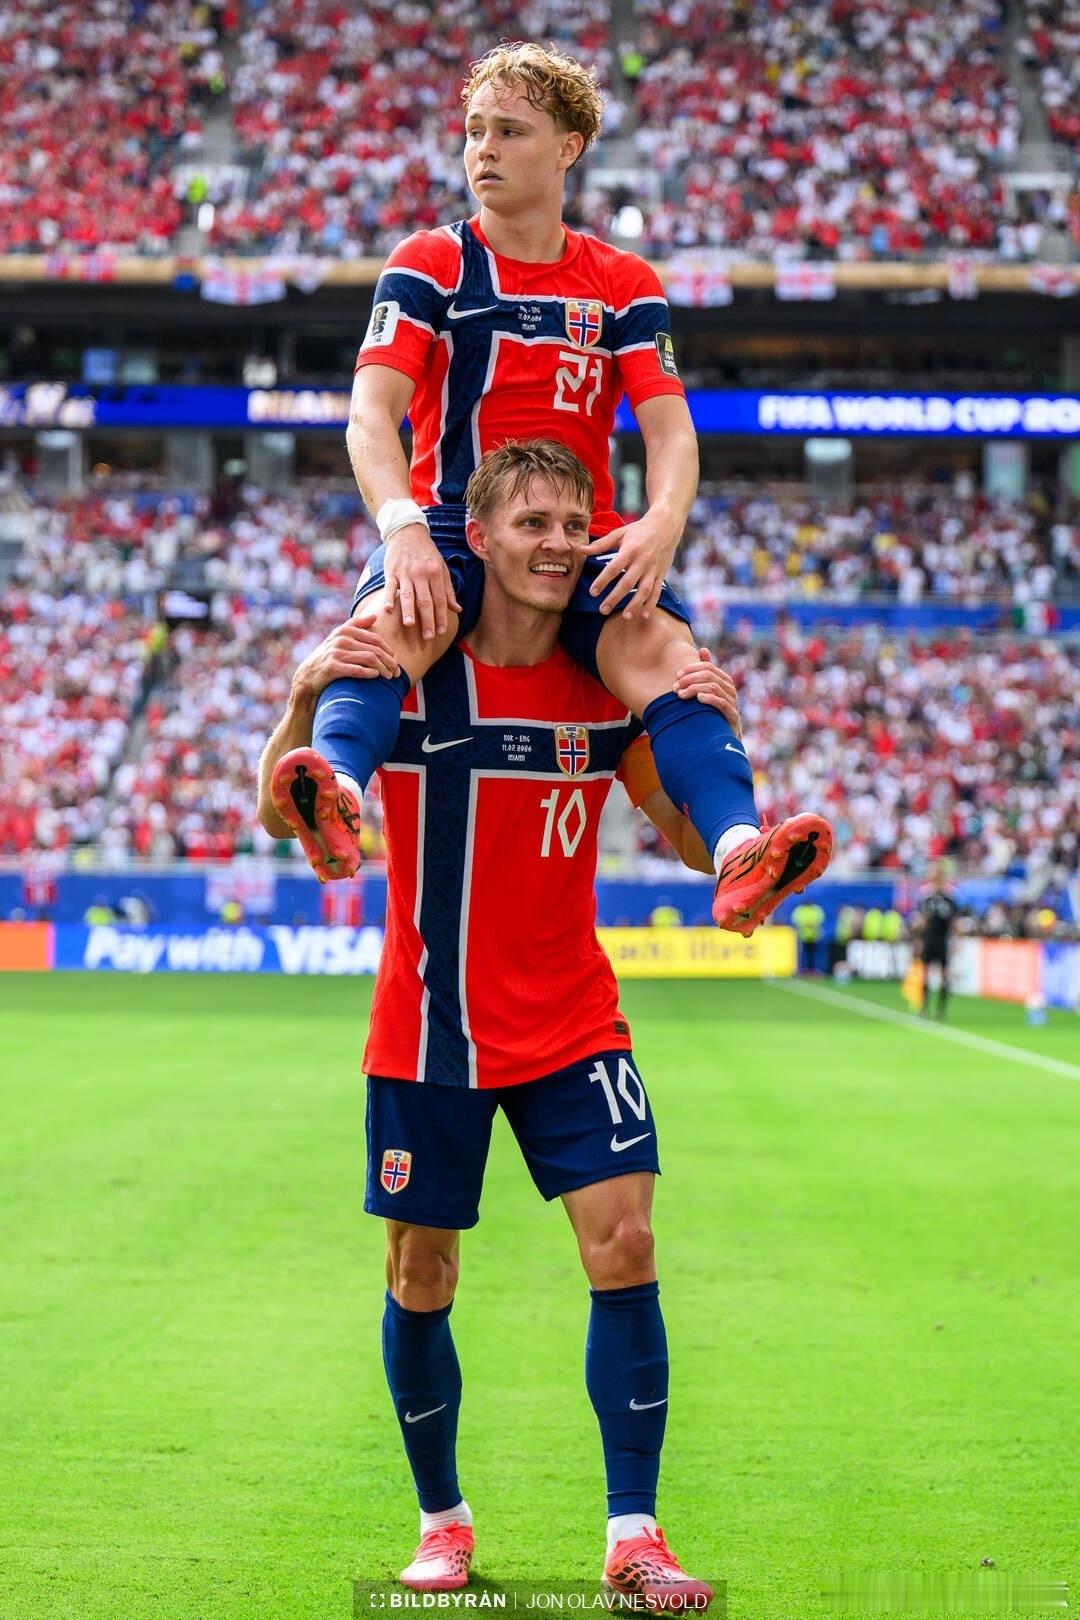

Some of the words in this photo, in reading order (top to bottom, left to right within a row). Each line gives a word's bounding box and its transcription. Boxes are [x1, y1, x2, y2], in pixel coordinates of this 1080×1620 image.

[553, 350, 603, 416] 21
[758, 395, 833, 430] FIFA
[834, 396, 952, 431] WORLD
[954, 397, 1022, 431] CUP
[540, 789, 587, 857] 10
[84, 926, 165, 974] Pay
[166, 926, 265, 972] with
[269, 925, 386, 974] VISA
[588, 1058, 645, 1125] 10
